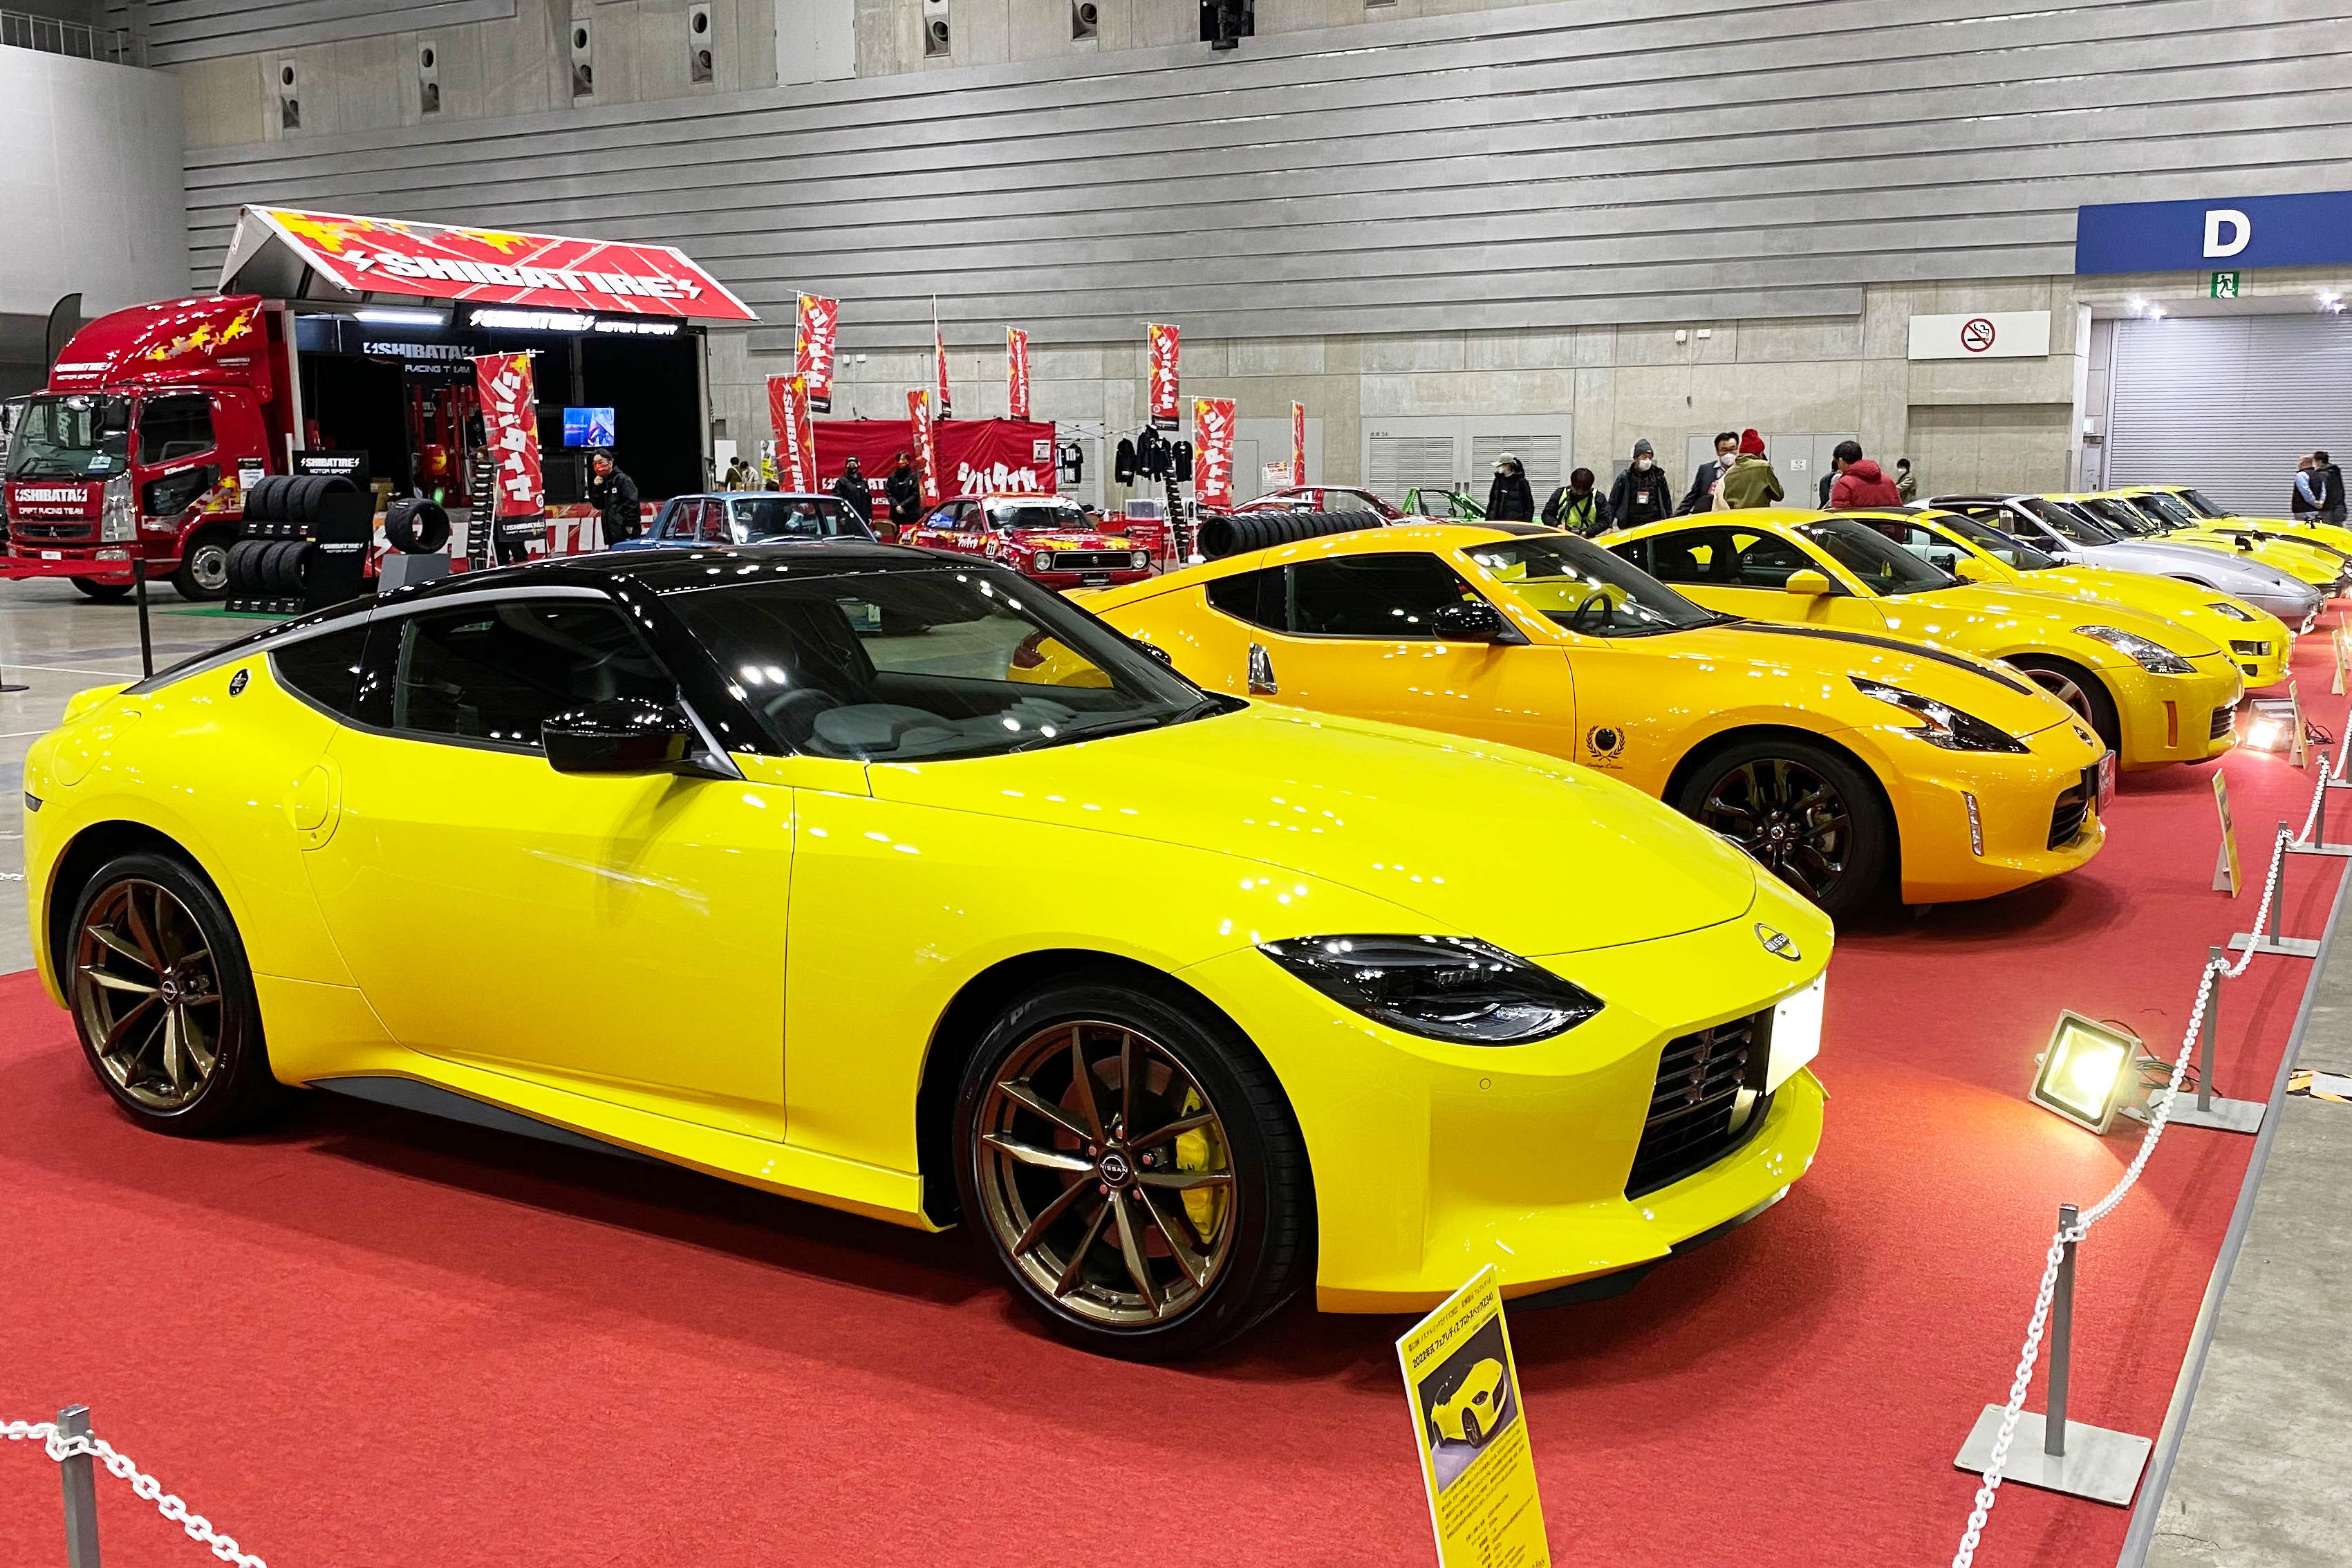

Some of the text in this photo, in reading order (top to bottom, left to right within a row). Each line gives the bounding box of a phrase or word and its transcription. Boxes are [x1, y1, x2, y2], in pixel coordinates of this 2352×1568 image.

[2203, 209, 2251, 257] D
[374, 252, 680, 298] SHIBATIRE
[480, 310, 586, 331] SHIBATIRE
[377, 343, 463, 360] SHIBATA
[404, 364, 441, 373] RACING
[306, 458, 355, 467] SHIBATIRE
[23, 488, 77, 502] SHIBATA
[1765, 934, 1787, 951] NISS
[1100, 1164, 1128, 1173] NISSAN
